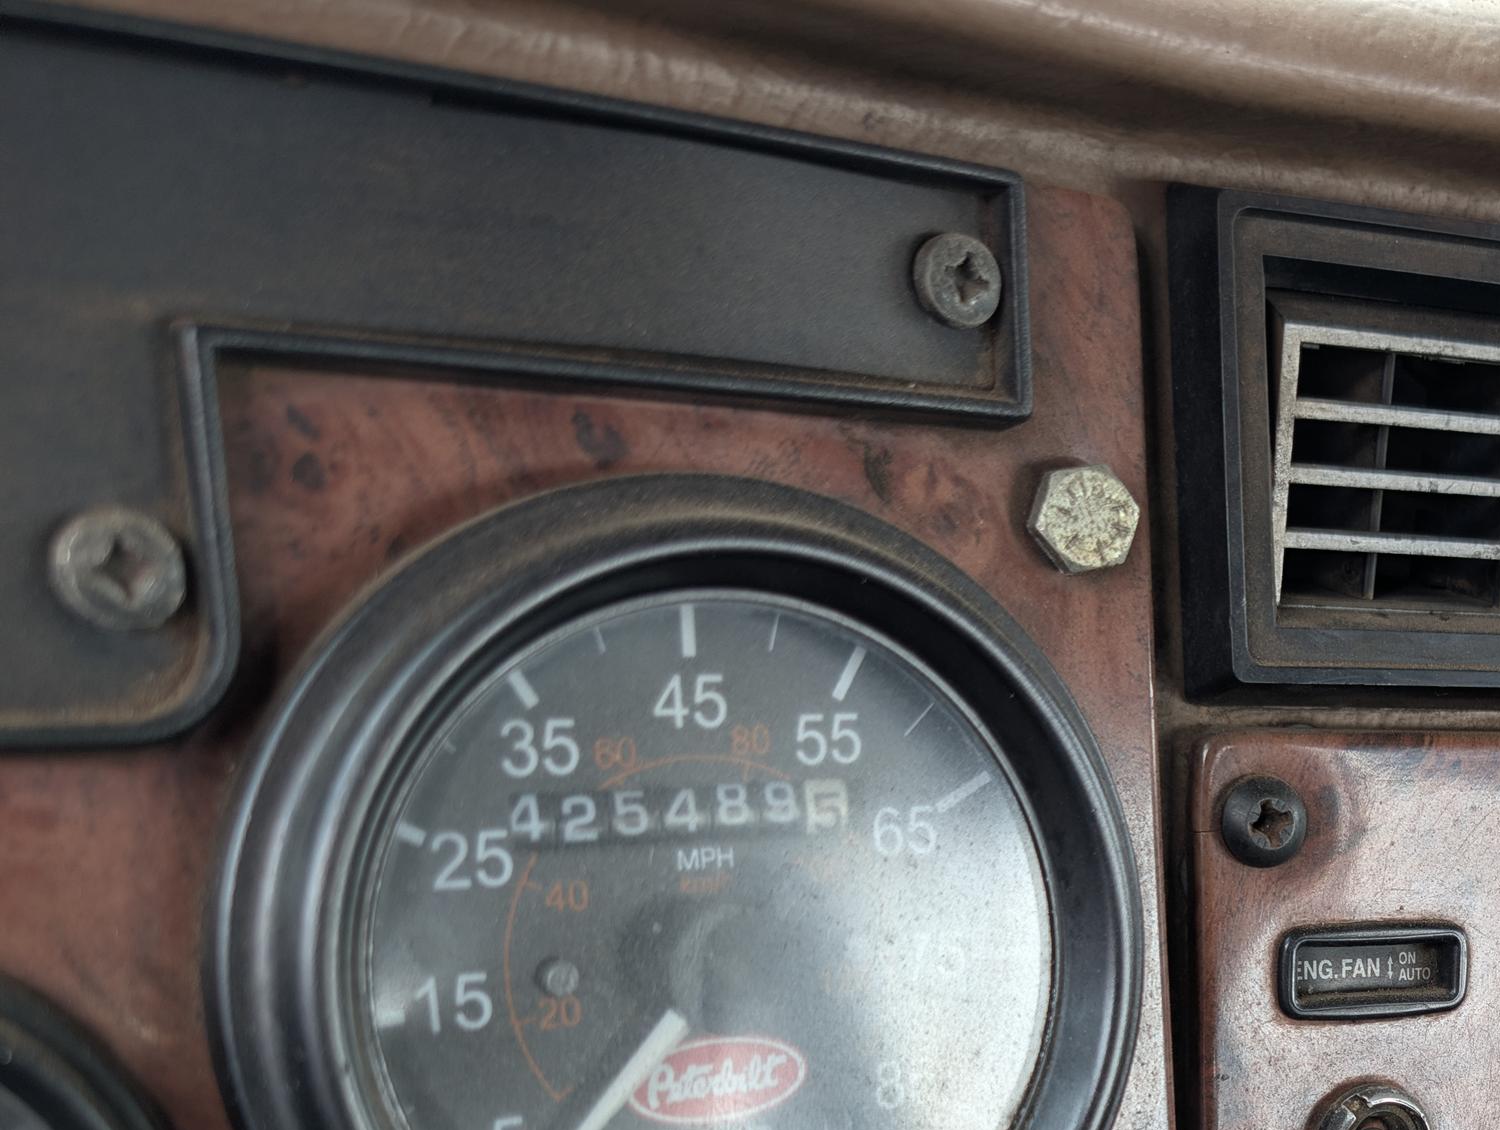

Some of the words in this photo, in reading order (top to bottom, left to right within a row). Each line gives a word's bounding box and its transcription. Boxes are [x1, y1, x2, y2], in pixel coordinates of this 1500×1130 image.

[653, 673, 728, 729] 45
[500, 718, 580, 778] 35
[731, 723, 771, 755] 80
[796, 712, 862, 766] 55
[872, 806, 940, 855] 65
[431, 829, 514, 891] 25
[677, 847, 734, 872] MPH
[545, 881, 589, 911] 40
[1399, 952, 1416, 966] ON
[1399, 967, 1431, 981] AUTO
[414, 973, 494, 1033] 15
[538, 1000, 584, 1031] 20
[648, 1053, 789, 1108] Peterbilt
